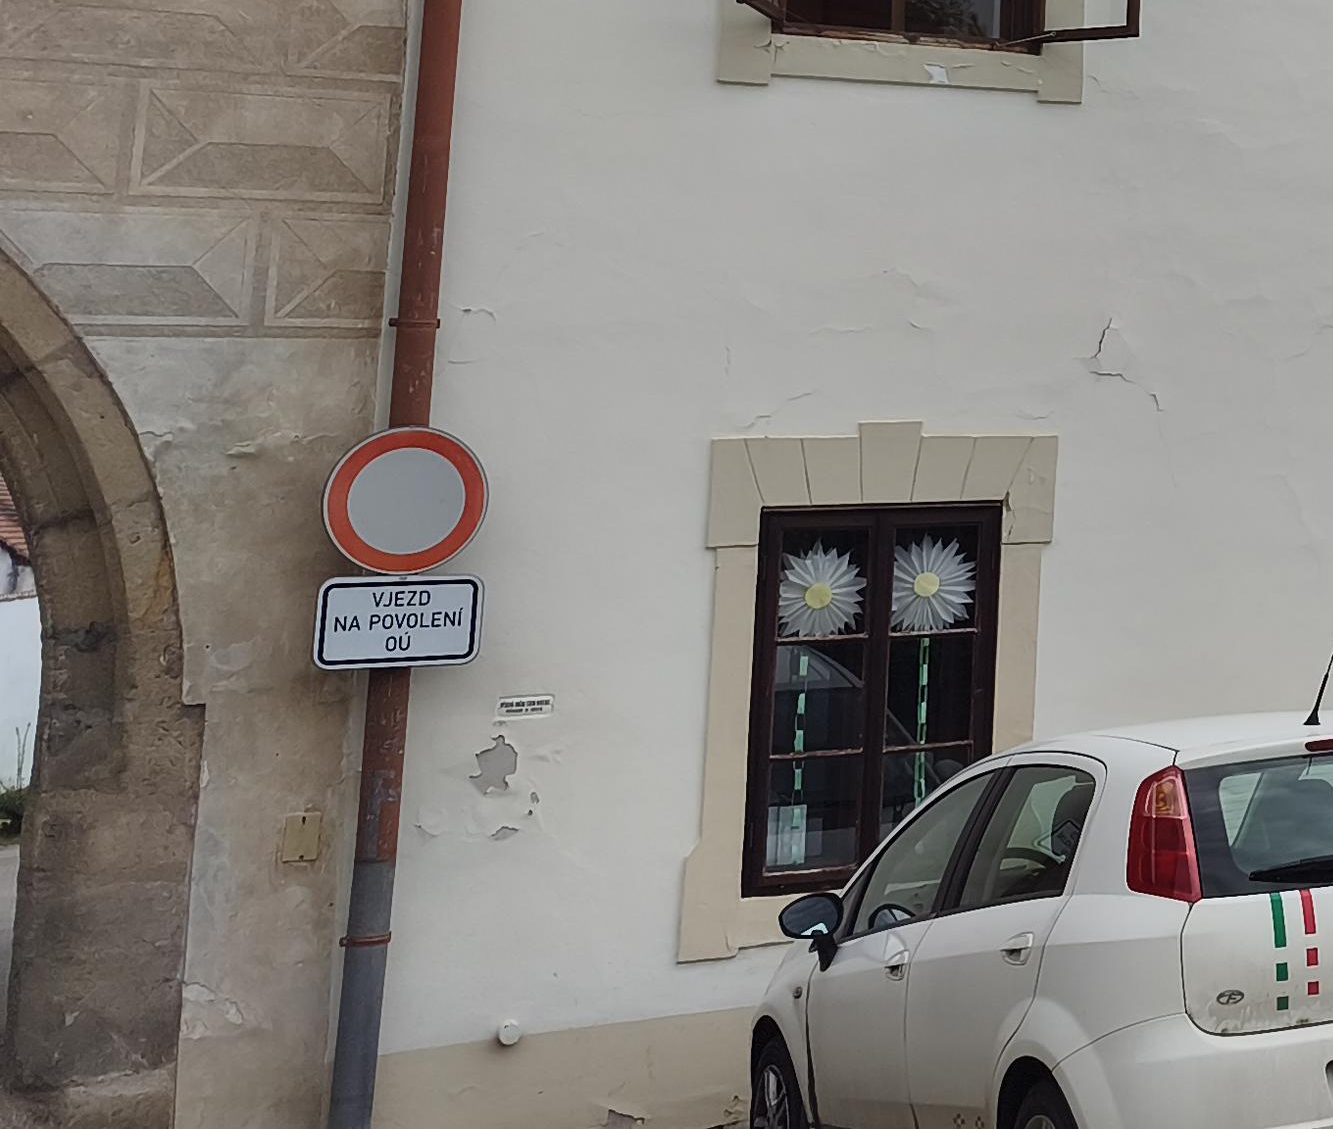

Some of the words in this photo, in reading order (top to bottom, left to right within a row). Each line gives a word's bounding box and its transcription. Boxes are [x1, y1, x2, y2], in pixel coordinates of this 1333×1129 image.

[372, 590, 431, 607] VJEZD
[334, 615, 361, 632] NA
[369, 607, 463, 631] POVOLENÍ
[385, 631, 411, 651] OÚ
